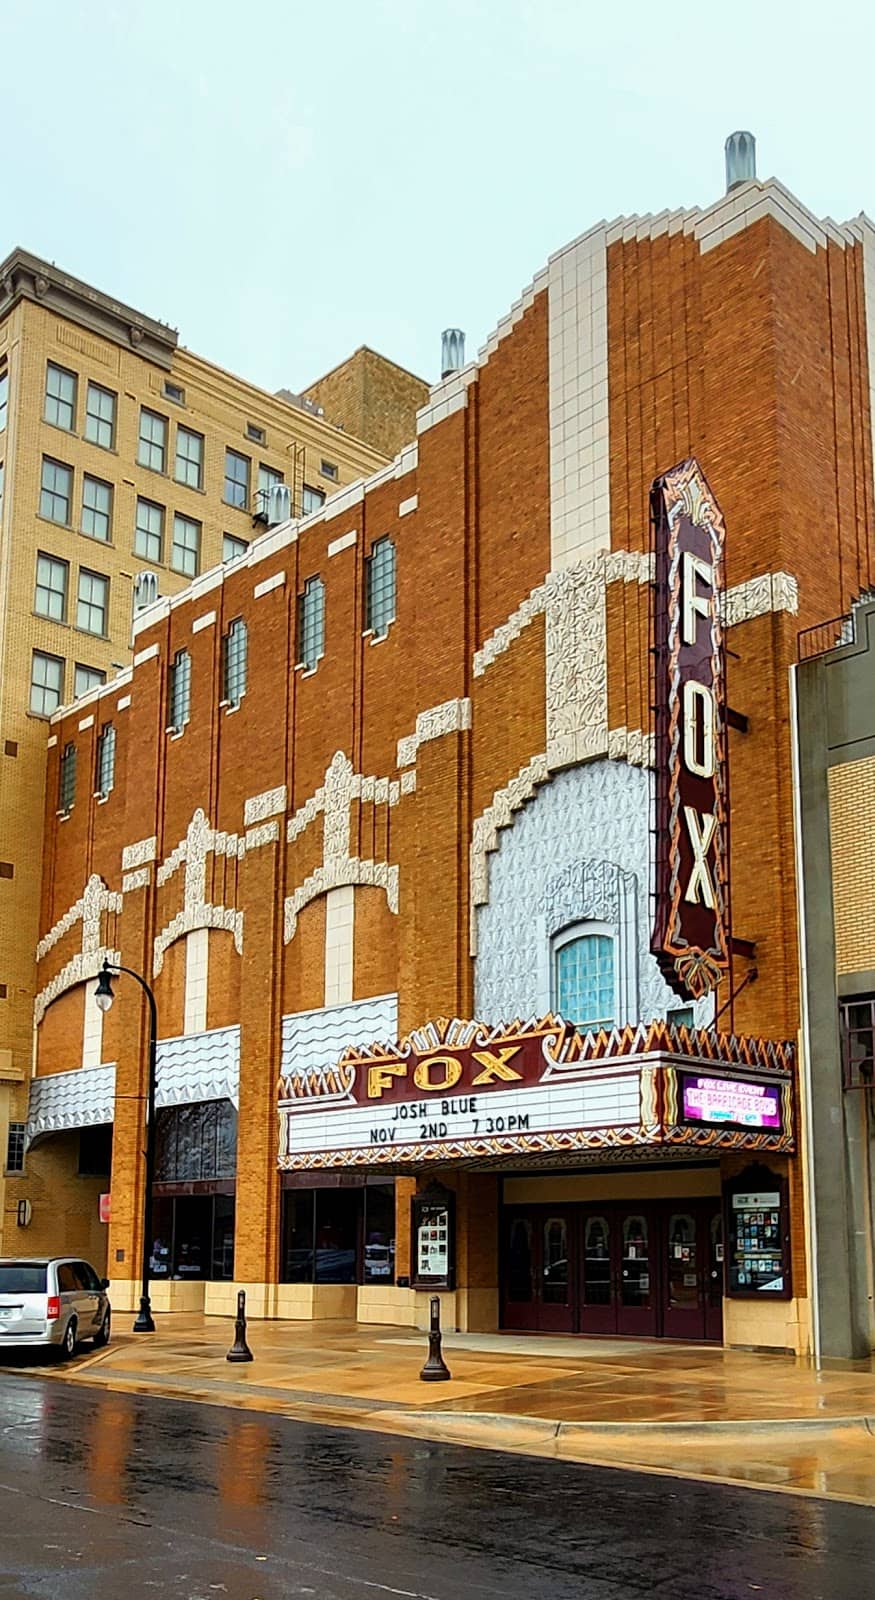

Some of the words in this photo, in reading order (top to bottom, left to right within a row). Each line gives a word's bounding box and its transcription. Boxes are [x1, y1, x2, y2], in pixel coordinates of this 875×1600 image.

[683, 551, 718, 909] FOX
[367, 1046, 524, 1098] FOX
[391, 1103, 428, 1121] JOSH
[441, 1097, 478, 1116] BLUE
[369, 1127, 396, 1143] NOV
[419, 1123, 448, 1139] 2ND
